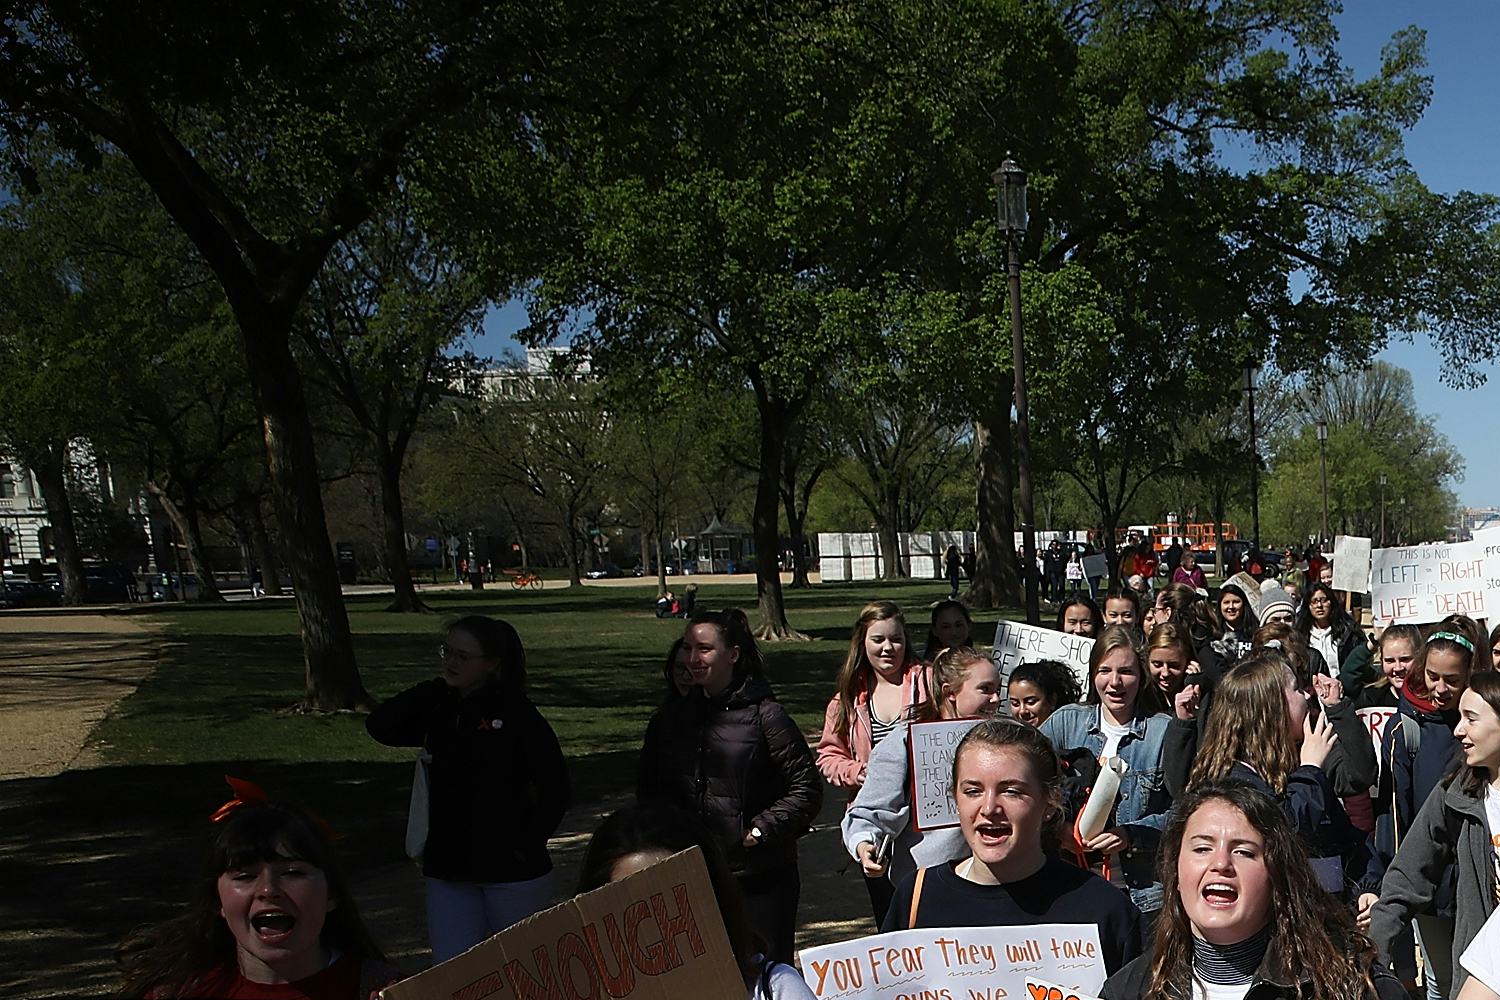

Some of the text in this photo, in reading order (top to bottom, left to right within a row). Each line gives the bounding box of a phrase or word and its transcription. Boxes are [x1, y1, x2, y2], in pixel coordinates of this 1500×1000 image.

[1398, 548, 1452, 560] THIS IS NOT
[1380, 565, 1419, 584] LEFT
[1440, 560, 1483, 580] RIGHT
[1411, 583, 1437, 594] IT IS
[1380, 598, 1418, 618] LIFE
[1435, 590, 1485, 613] DEATH
[998, 623, 1050, 654] THERE
[920, 732, 943, 747] THE
[923, 767, 943, 781] THE
[811, 957, 863, 997] YOU
[1006, 940, 1042, 964] will
[1050, 938, 1096, 960] take
